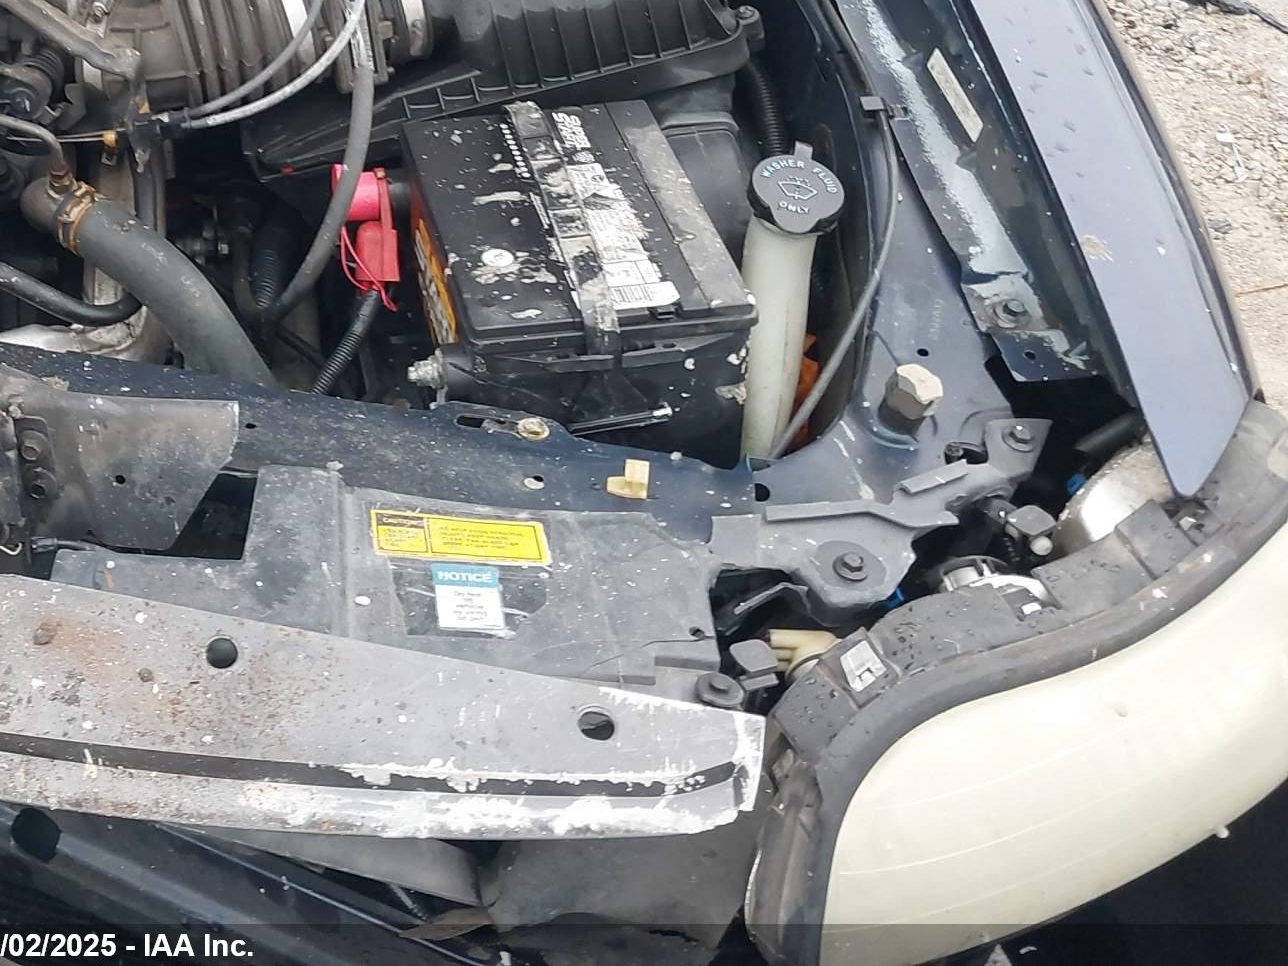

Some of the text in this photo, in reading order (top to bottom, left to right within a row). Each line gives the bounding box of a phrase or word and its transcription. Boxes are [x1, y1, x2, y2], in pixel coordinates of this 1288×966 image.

[760, 159, 838, 193] WASHER FLUID
[779, 201, 809, 213] ONLY
[437, 571, 493, 583] NOTICE
